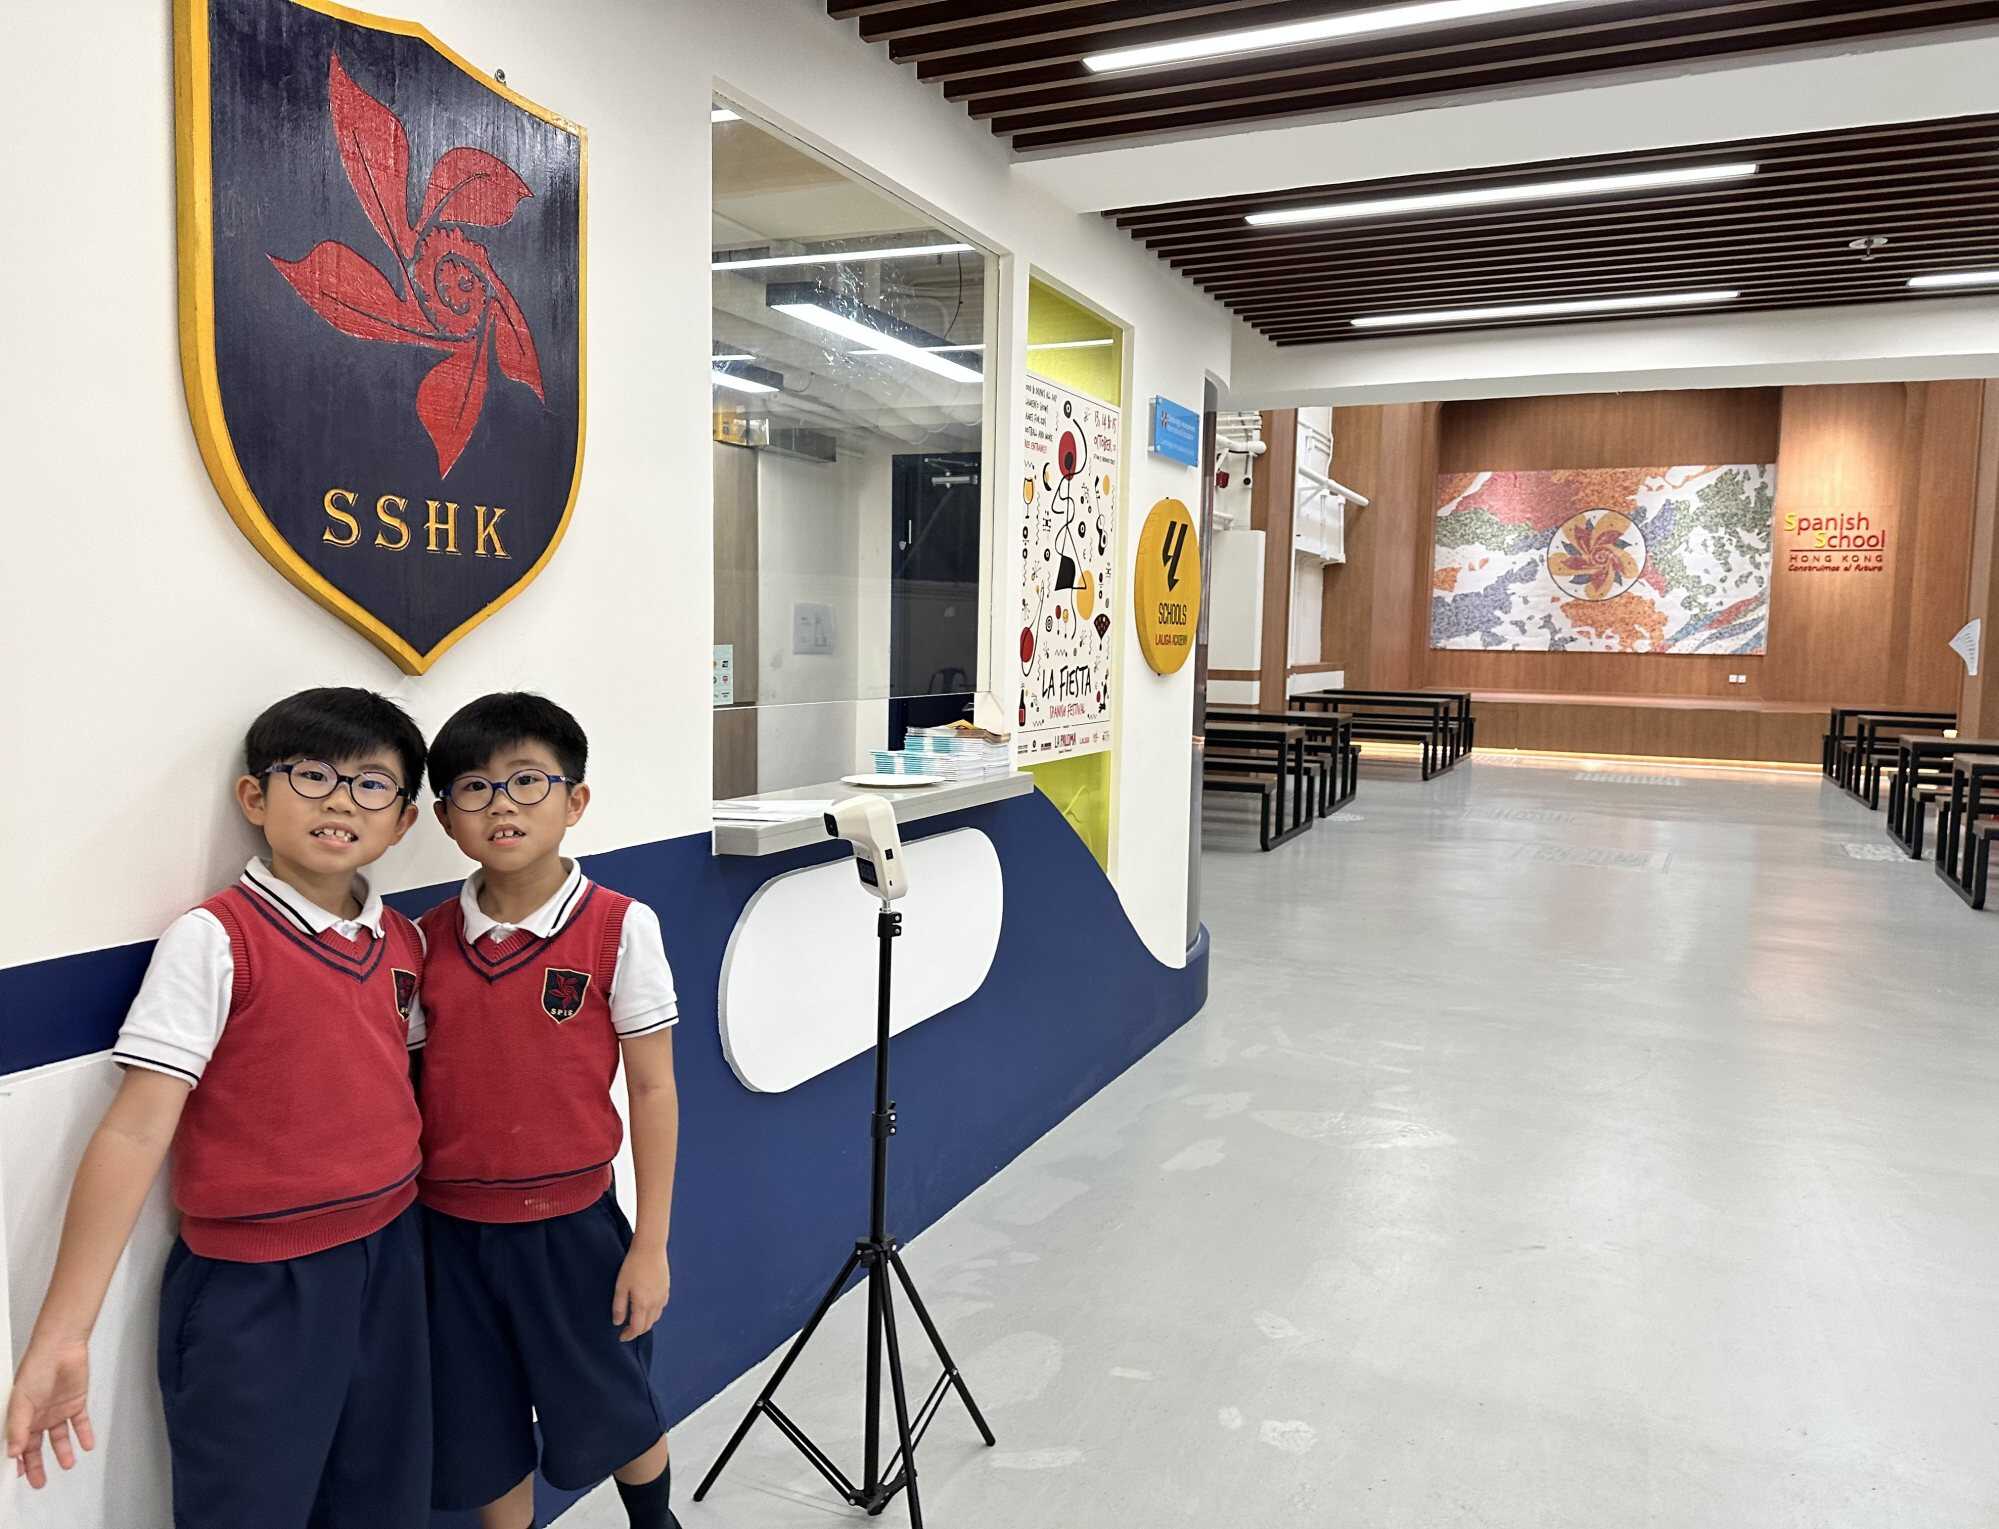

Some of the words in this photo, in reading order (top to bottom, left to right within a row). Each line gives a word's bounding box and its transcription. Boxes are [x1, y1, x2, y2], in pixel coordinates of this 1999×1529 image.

[321, 488, 512, 559] SSHK
[1784, 512, 1870, 536] Spanish
[1814, 530, 1886, 548] School
[1789, 554, 1832, 563] HONG
[1842, 554, 1883, 563] KONG
[1158, 602, 1187, 625] SCHOOLS
[1041, 668, 1055, 699] LA
[1059, 665, 1091, 702] FIESTA
[550, 1007, 574, 1017] SPIS
